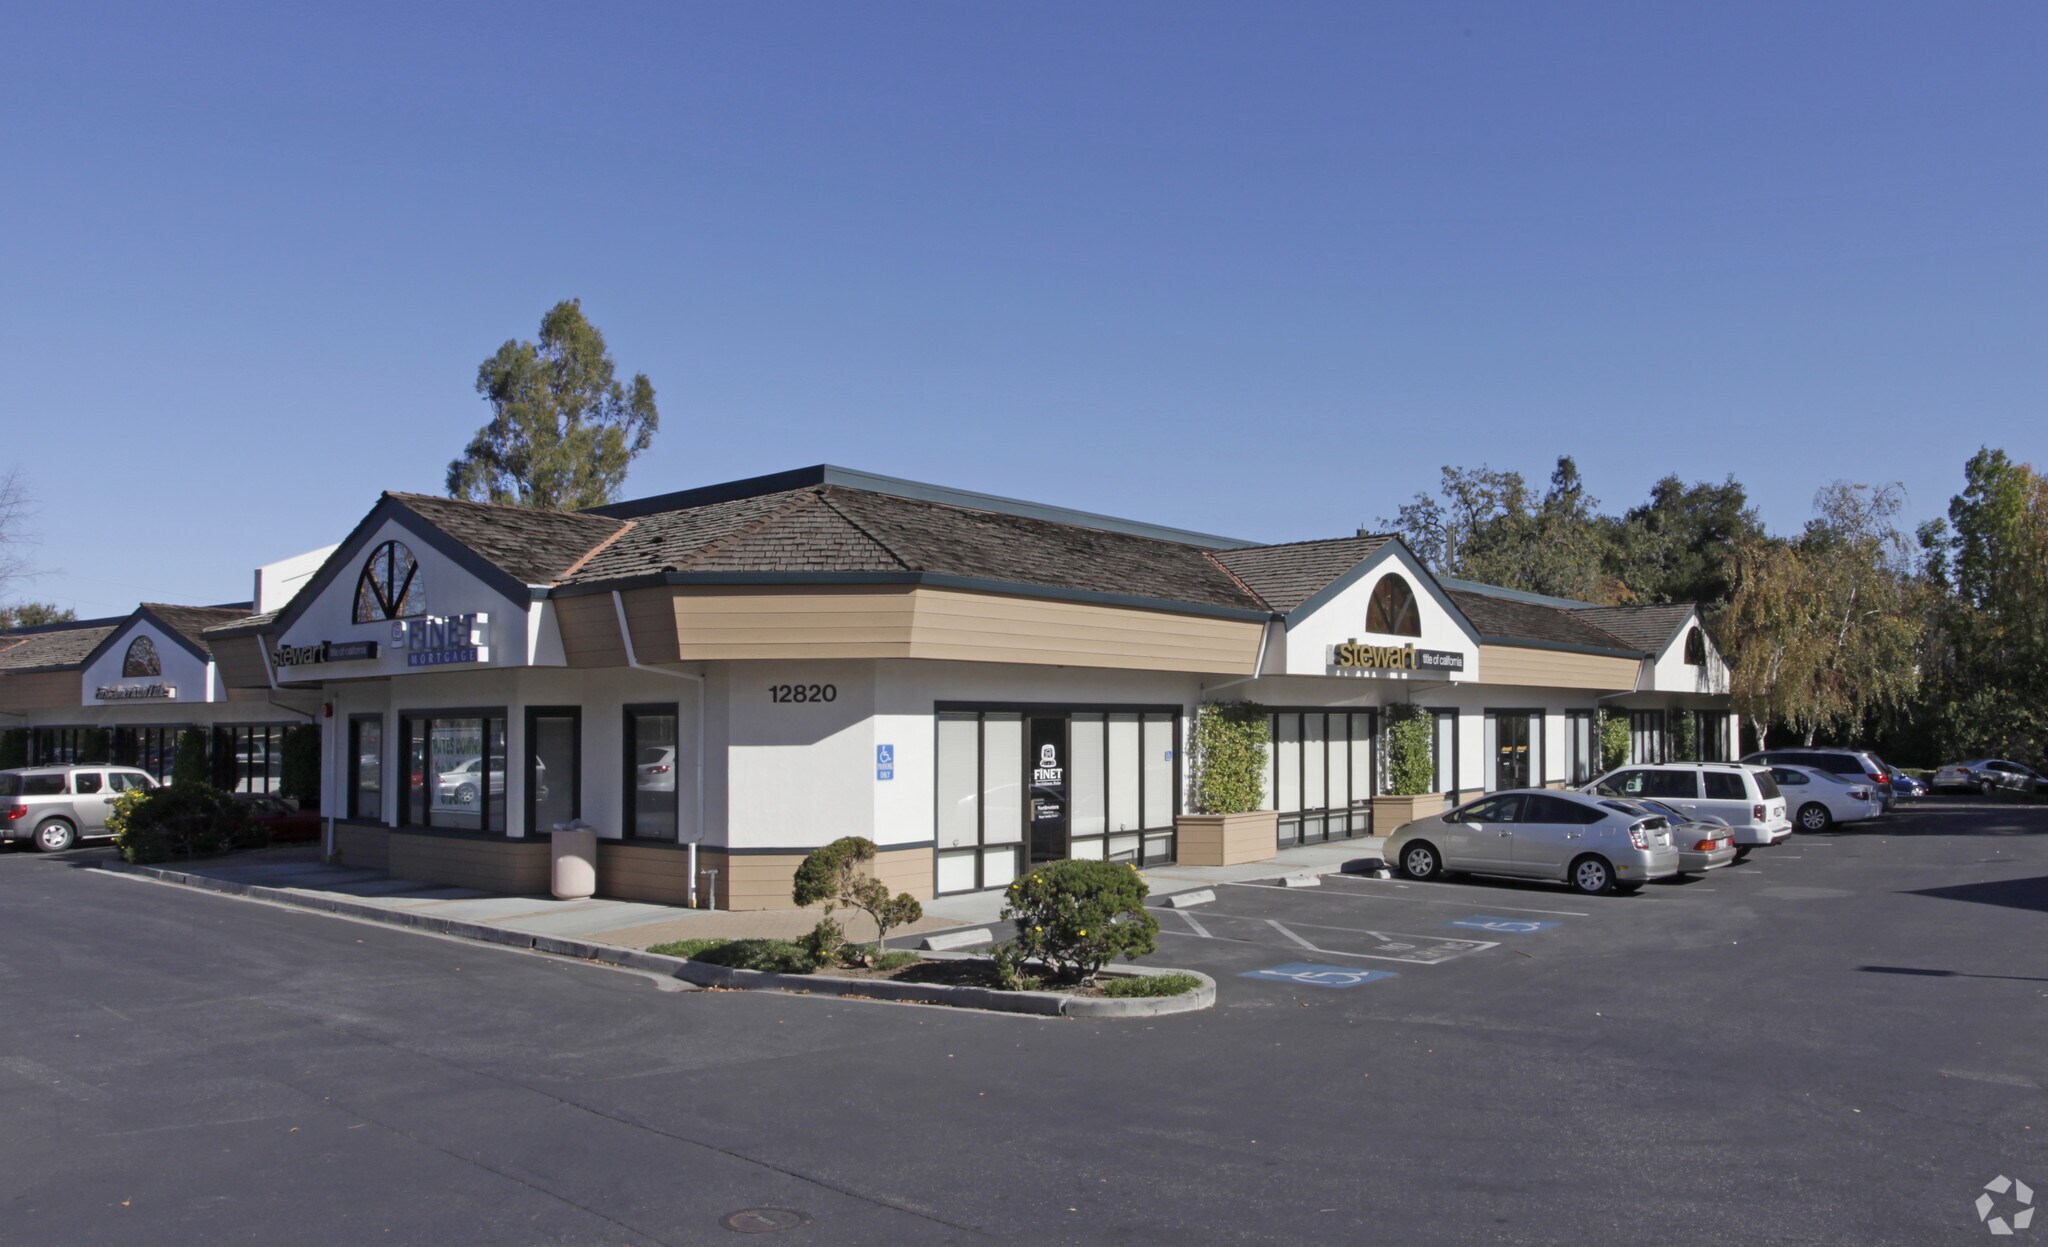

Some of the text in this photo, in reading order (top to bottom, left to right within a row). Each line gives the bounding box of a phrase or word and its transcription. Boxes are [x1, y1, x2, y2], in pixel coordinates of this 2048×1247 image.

[271, 641, 326, 667] stewart
[411, 650, 475, 665] MORTGAGE
[1340, 638, 1417, 670] stewart
[1433, 654, 1440, 665] of
[1440, 655, 1463, 667] california
[768, 684, 837, 703] 12820
[1034, 768, 1063, 780] FINET
